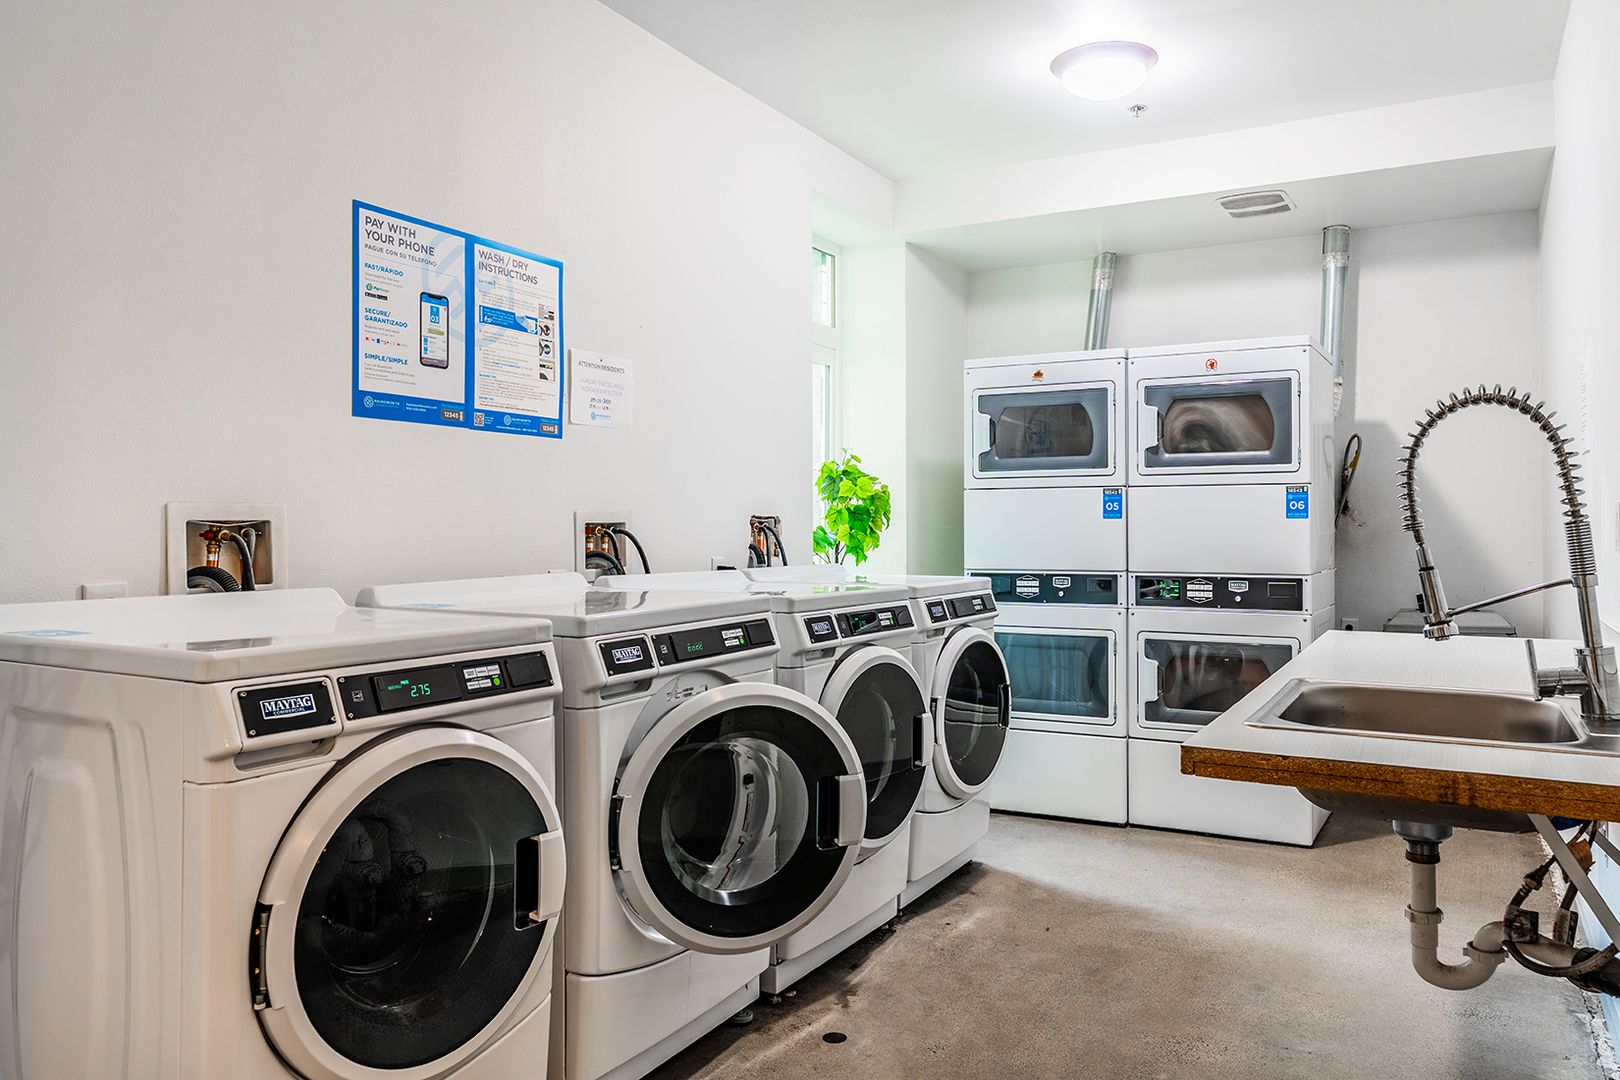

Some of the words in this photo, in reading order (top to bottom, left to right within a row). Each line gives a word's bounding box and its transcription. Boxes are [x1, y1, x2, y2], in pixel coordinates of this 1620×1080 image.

[365, 216, 384, 230] PAY
[387, 222, 416, 239] WITH
[364, 229, 395, 246] YOUR
[398, 238, 435, 256] PHONE
[364, 243, 384, 253] PAGUE
[385, 248, 398, 257] CON
[478, 249, 505, 264] WASH
[512, 259, 529, 271] DRY
[478, 261, 538, 285] INSTRUCTIONS
[364, 307, 391, 317] SECURE/
[430, 314, 440, 323] 03
[364, 314, 408, 328] GARANTIZADO
[364, 352, 408, 366] SIMPLE/SIMPLE
[1105, 502, 1119, 511] 05
[1289, 500, 1305, 510] 06
[410, 683, 431, 697] 2.75
[263, 696, 312, 713] MAYTAG
